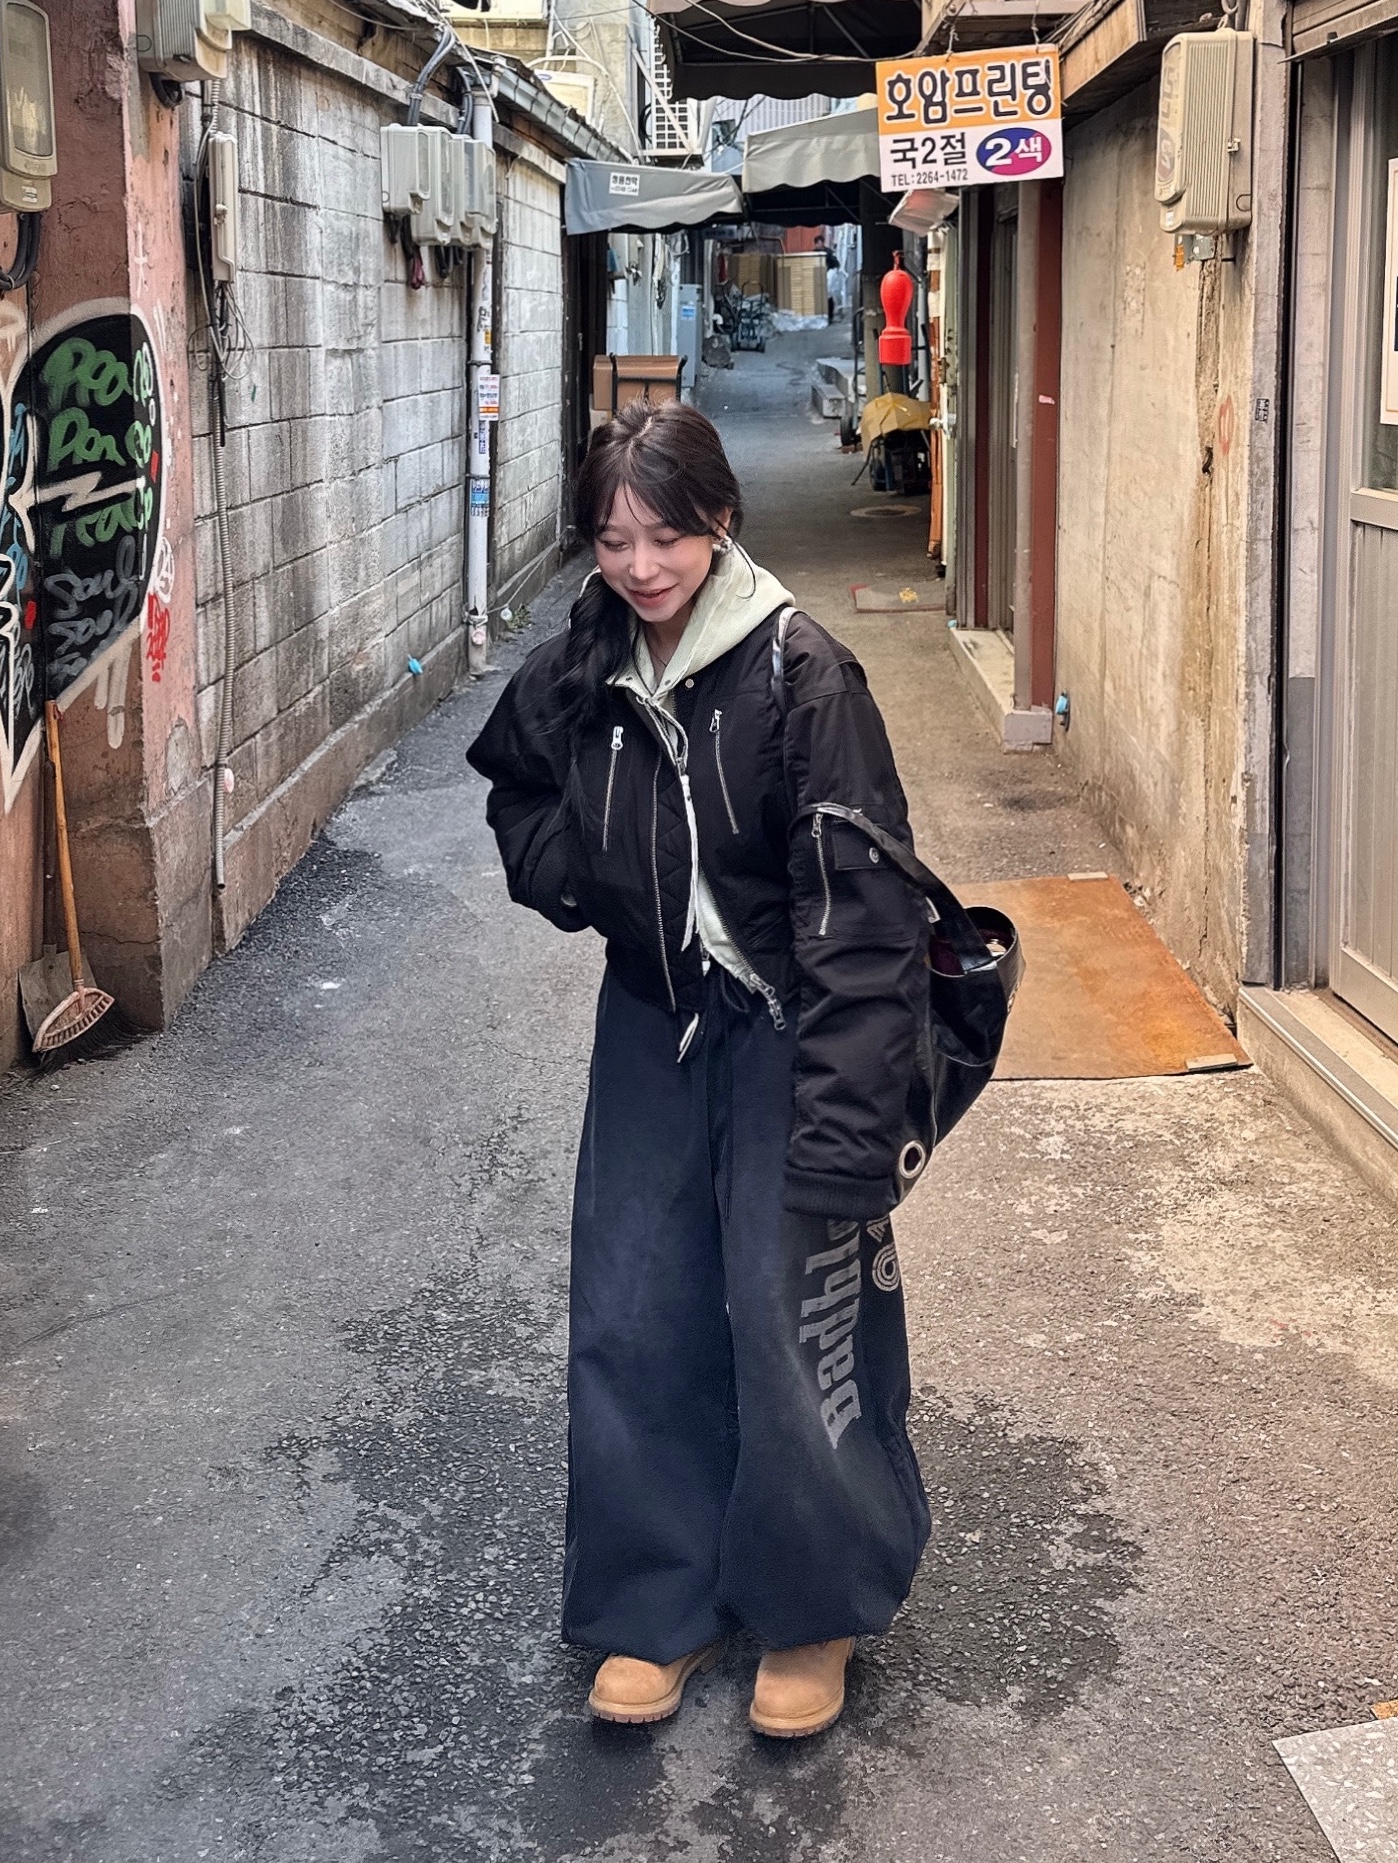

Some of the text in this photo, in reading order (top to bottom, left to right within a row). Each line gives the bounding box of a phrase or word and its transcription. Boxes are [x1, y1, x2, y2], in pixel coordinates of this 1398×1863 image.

[886, 59, 1052, 124] 호암프린팅
[890, 132, 967, 169] 국2절
[985, 136, 1043, 167] 2색
[891, 168, 969, 187] TEL:2264-1472
